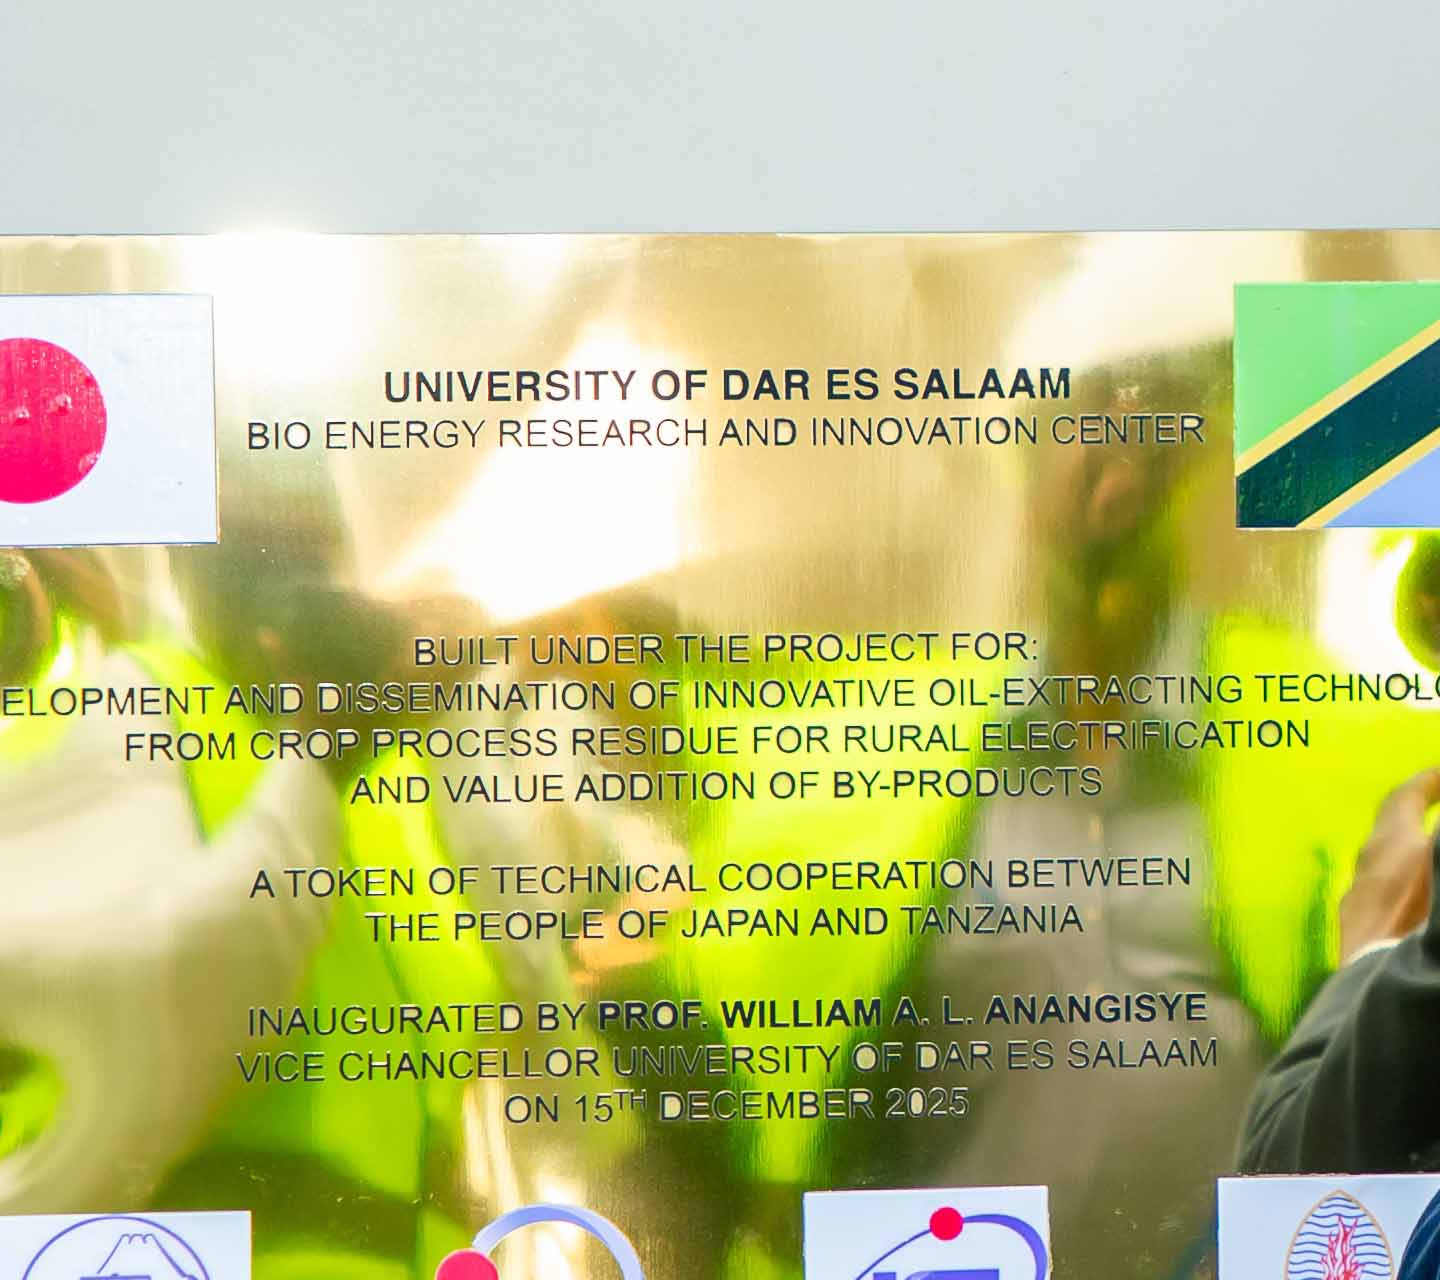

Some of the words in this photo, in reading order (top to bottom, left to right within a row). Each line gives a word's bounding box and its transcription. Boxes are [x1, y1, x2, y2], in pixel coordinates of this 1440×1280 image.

[384, 370, 636, 403] UNIVERSITY
[651, 369, 707, 402] OF
[723, 369, 810, 401] DAR
[827, 368, 879, 400] ES
[893, 367, 1071, 400] SALAAM
[247, 421, 311, 450] BIO
[325, 419, 486, 450] ENERGY
[499, 418, 707, 448] RESEARCH
[718, 417, 797, 447] AND
[812, 415, 1037, 447] INNOVATION
[1051, 413, 1205, 445] CENTER
[414, 636, 519, 666] BUILT
[530, 634, 664, 665] UNDER
[675, 634, 749, 664] THE
[763, 632, 940, 663] PROJECT
[951, 632, 1039, 662] FOR:
[224, 684, 304, 715] AND
[317, 682, 616, 714] DISSEMINATION
[628, 681, 680, 711] OF
[694, 677, 915, 710] INNOVATIVE
[929, 674, 1243, 707] OIL-EXTRACTING
[125, 732, 236, 762] FROM
[249, 729, 359, 760] CROP
[372, 728, 557, 759] PROCESS
[571, 726, 738, 757] RESIDUE
[752, 725, 831, 755] FOR
[844, 723, 969, 754] RURAL
[981, 719, 1311, 753] ELECTRIFICATION
[350, 776, 430, 805] AND
[442, 774, 564, 804] VALUE
[574, 772, 755, 802] ADDITION
[769, 771, 819, 800] OF
[832, 767, 1104, 799] BY-PRODUCTS
[249, 869, 275, 898] A
[283, 867, 414, 897] TOKEN
[428, 866, 479, 895] OF
[491, 864, 706, 894] TECHNICAL
[718, 859, 994, 891] COOPERATION
[1007, 857, 1191, 888] BETWEEN
[364, 912, 440, 941] THE
[454, 910, 604, 941] PEOPLE
[617, 909, 668, 938] OF
[681, 908, 798, 937] JAPAN
[809, 907, 889, 936] AND
[900, 904, 1084, 935] TANZANIA
[248, 1003, 524, 1036] INAUGURATED
[537, 1002, 586, 1032] BY
[598, 1000, 708, 1031] PROF.
[721, 998, 881, 1029] WILLIAM
[892, 997, 928, 1027] A.
[943, 996, 974, 1025] L.
[984, 993, 1208, 1025] ANANGISYE
[235, 1052, 324, 1082] VICE
[338, 1048, 601, 1082] CHANCELLOR
[613, 1044, 839, 1077] UNIVERSITY
[851, 1043, 903, 1074] OF
[915, 1041, 994, 1072] DAR
[1007, 1040, 1055, 1070] ES
[1067, 1038, 1217, 1069] SALAAM
[504, 1095, 559, 1123] ON
[574, 1089, 648, 1122] 15TH
[660, 1089, 876, 1121] DECEMBER
[885, 1087, 970, 1119] 2025
